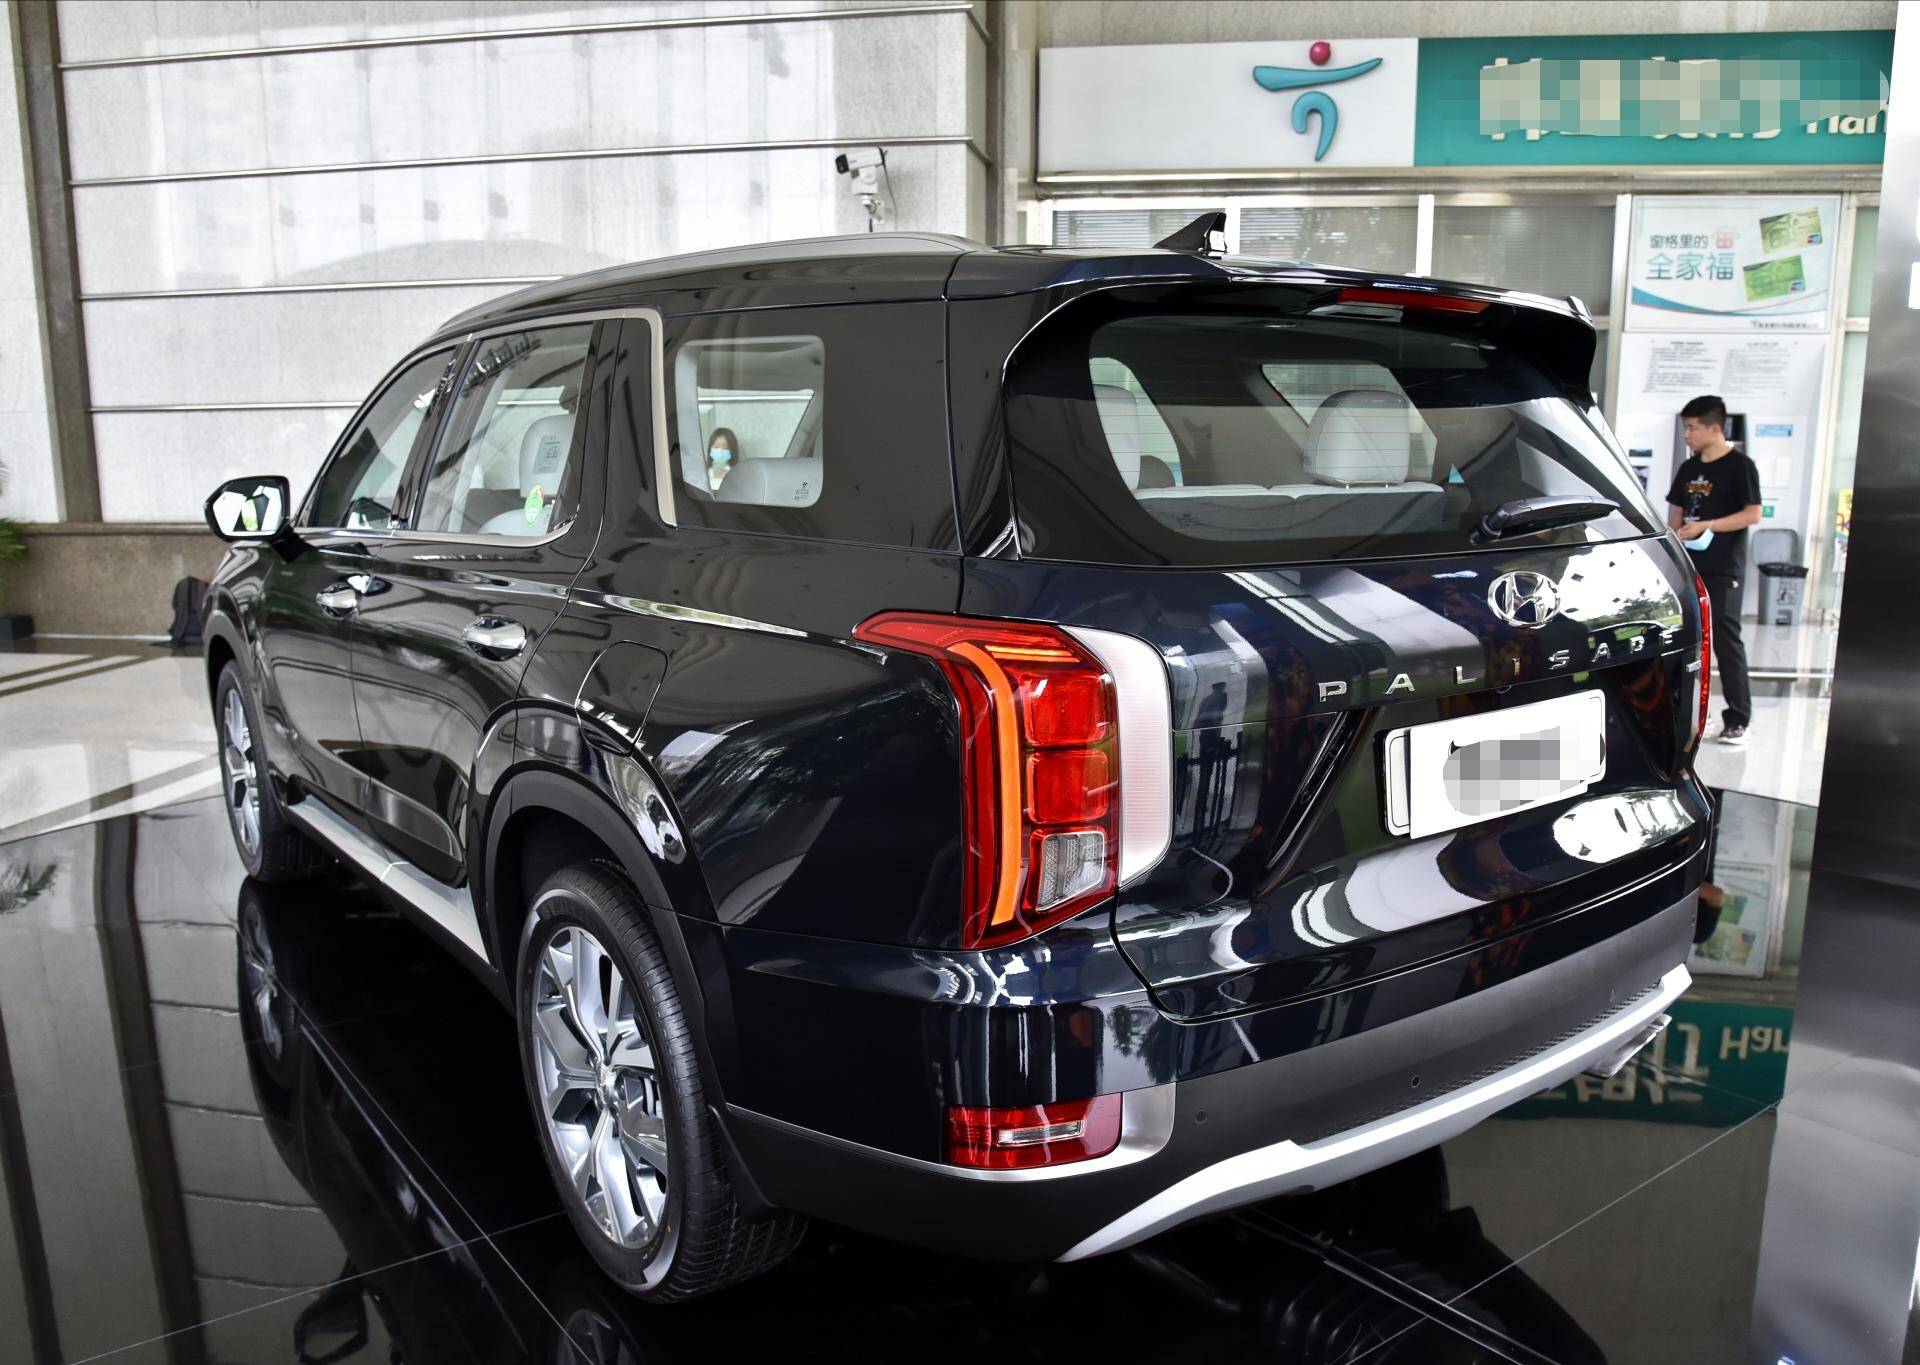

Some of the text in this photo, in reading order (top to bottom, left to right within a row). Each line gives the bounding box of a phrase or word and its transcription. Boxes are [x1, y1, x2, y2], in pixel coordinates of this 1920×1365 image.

[1646, 251, 1736, 281] 全家福
[1318, 629, 1674, 702] PALISADE
